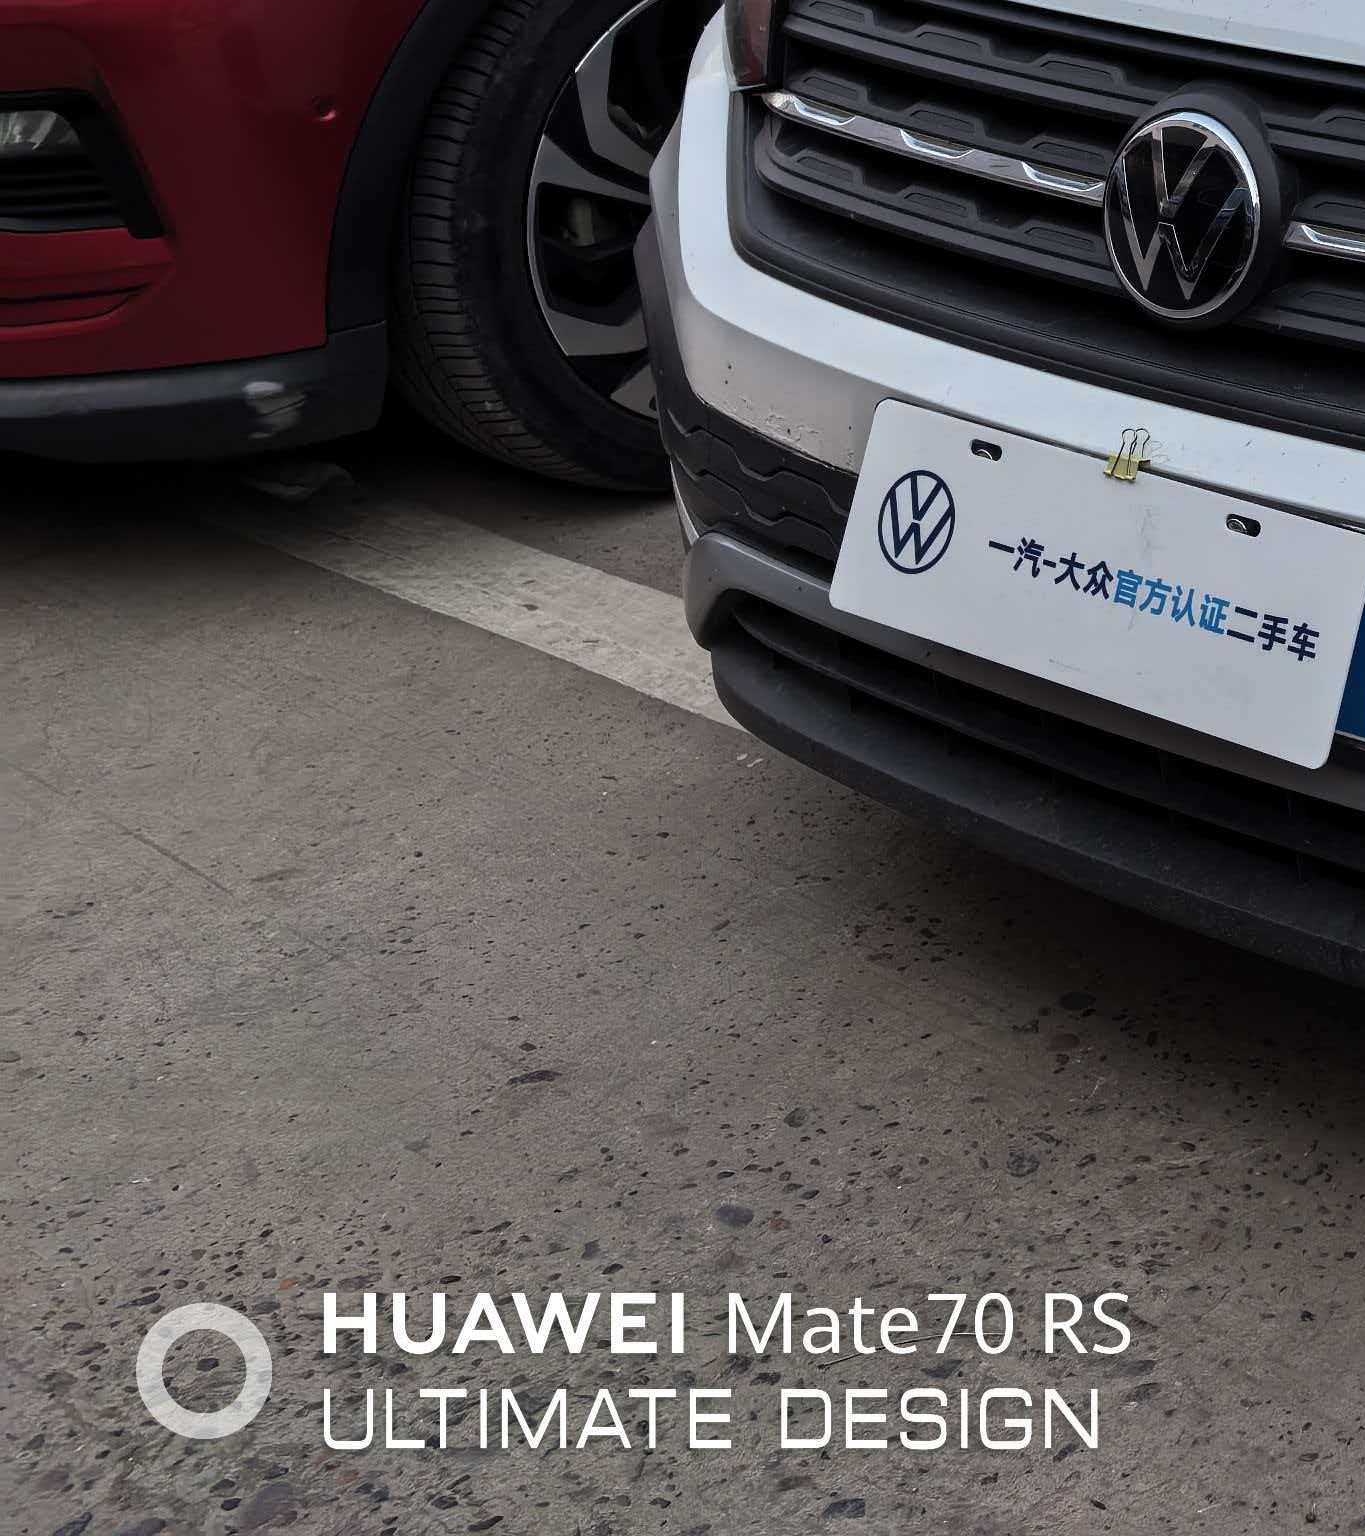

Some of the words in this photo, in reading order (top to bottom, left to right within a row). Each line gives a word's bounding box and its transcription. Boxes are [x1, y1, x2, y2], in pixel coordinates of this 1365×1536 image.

[989, 536, 1321, 662] 一汽-大众官方认证二手车
